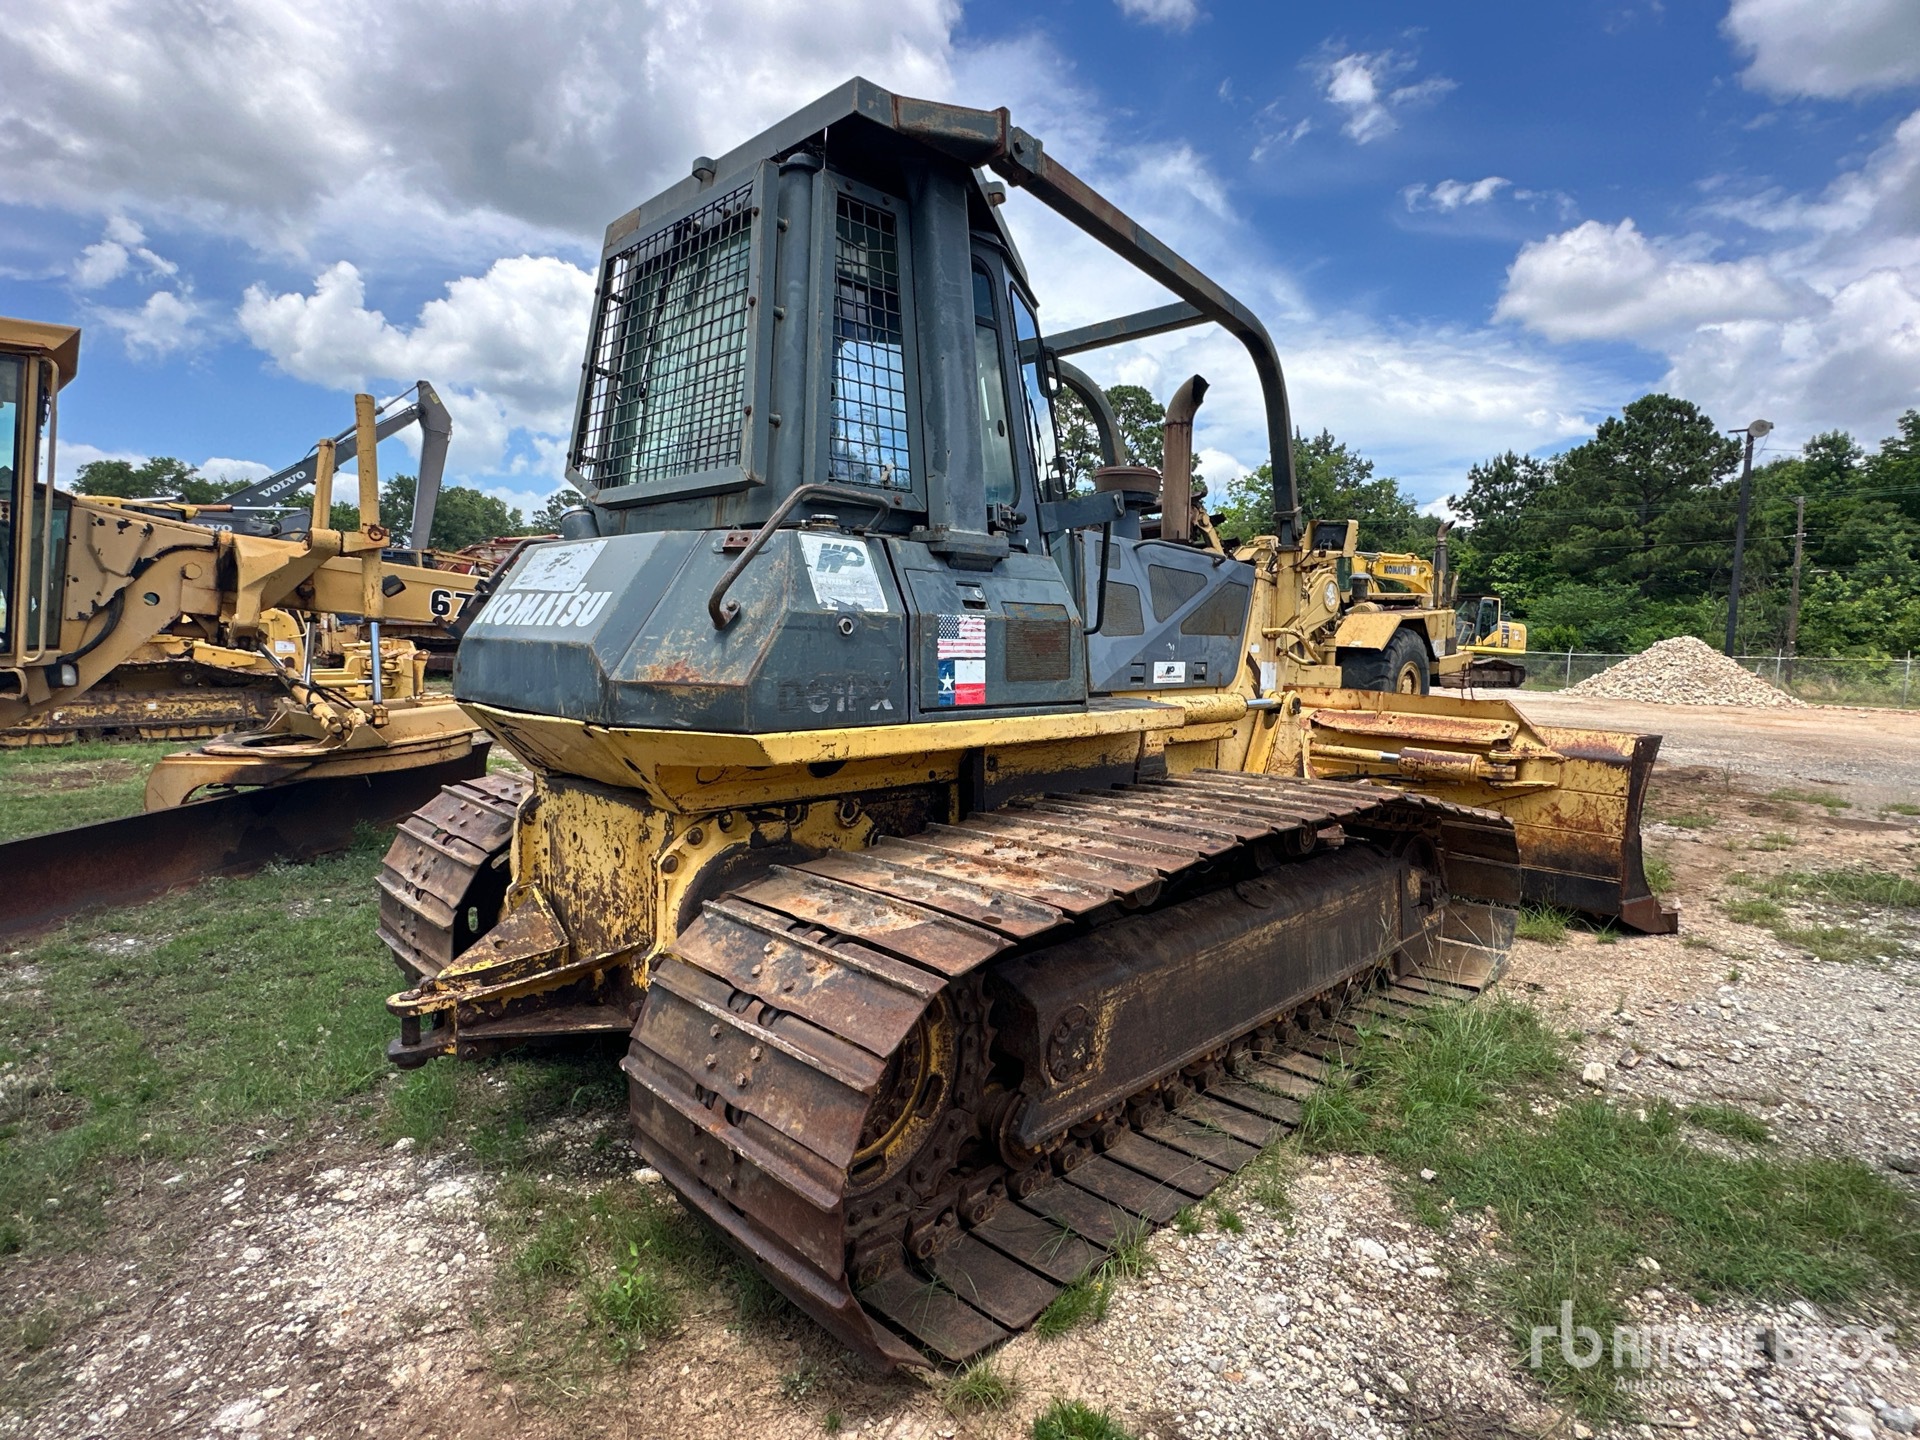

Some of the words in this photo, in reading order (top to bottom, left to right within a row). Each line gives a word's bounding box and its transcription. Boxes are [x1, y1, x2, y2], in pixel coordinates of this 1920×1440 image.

[258, 470, 307, 498] VOLVO
[1384, 564, 1412, 576] KOMATSU
[476, 583, 613, 628] KOMATSU
